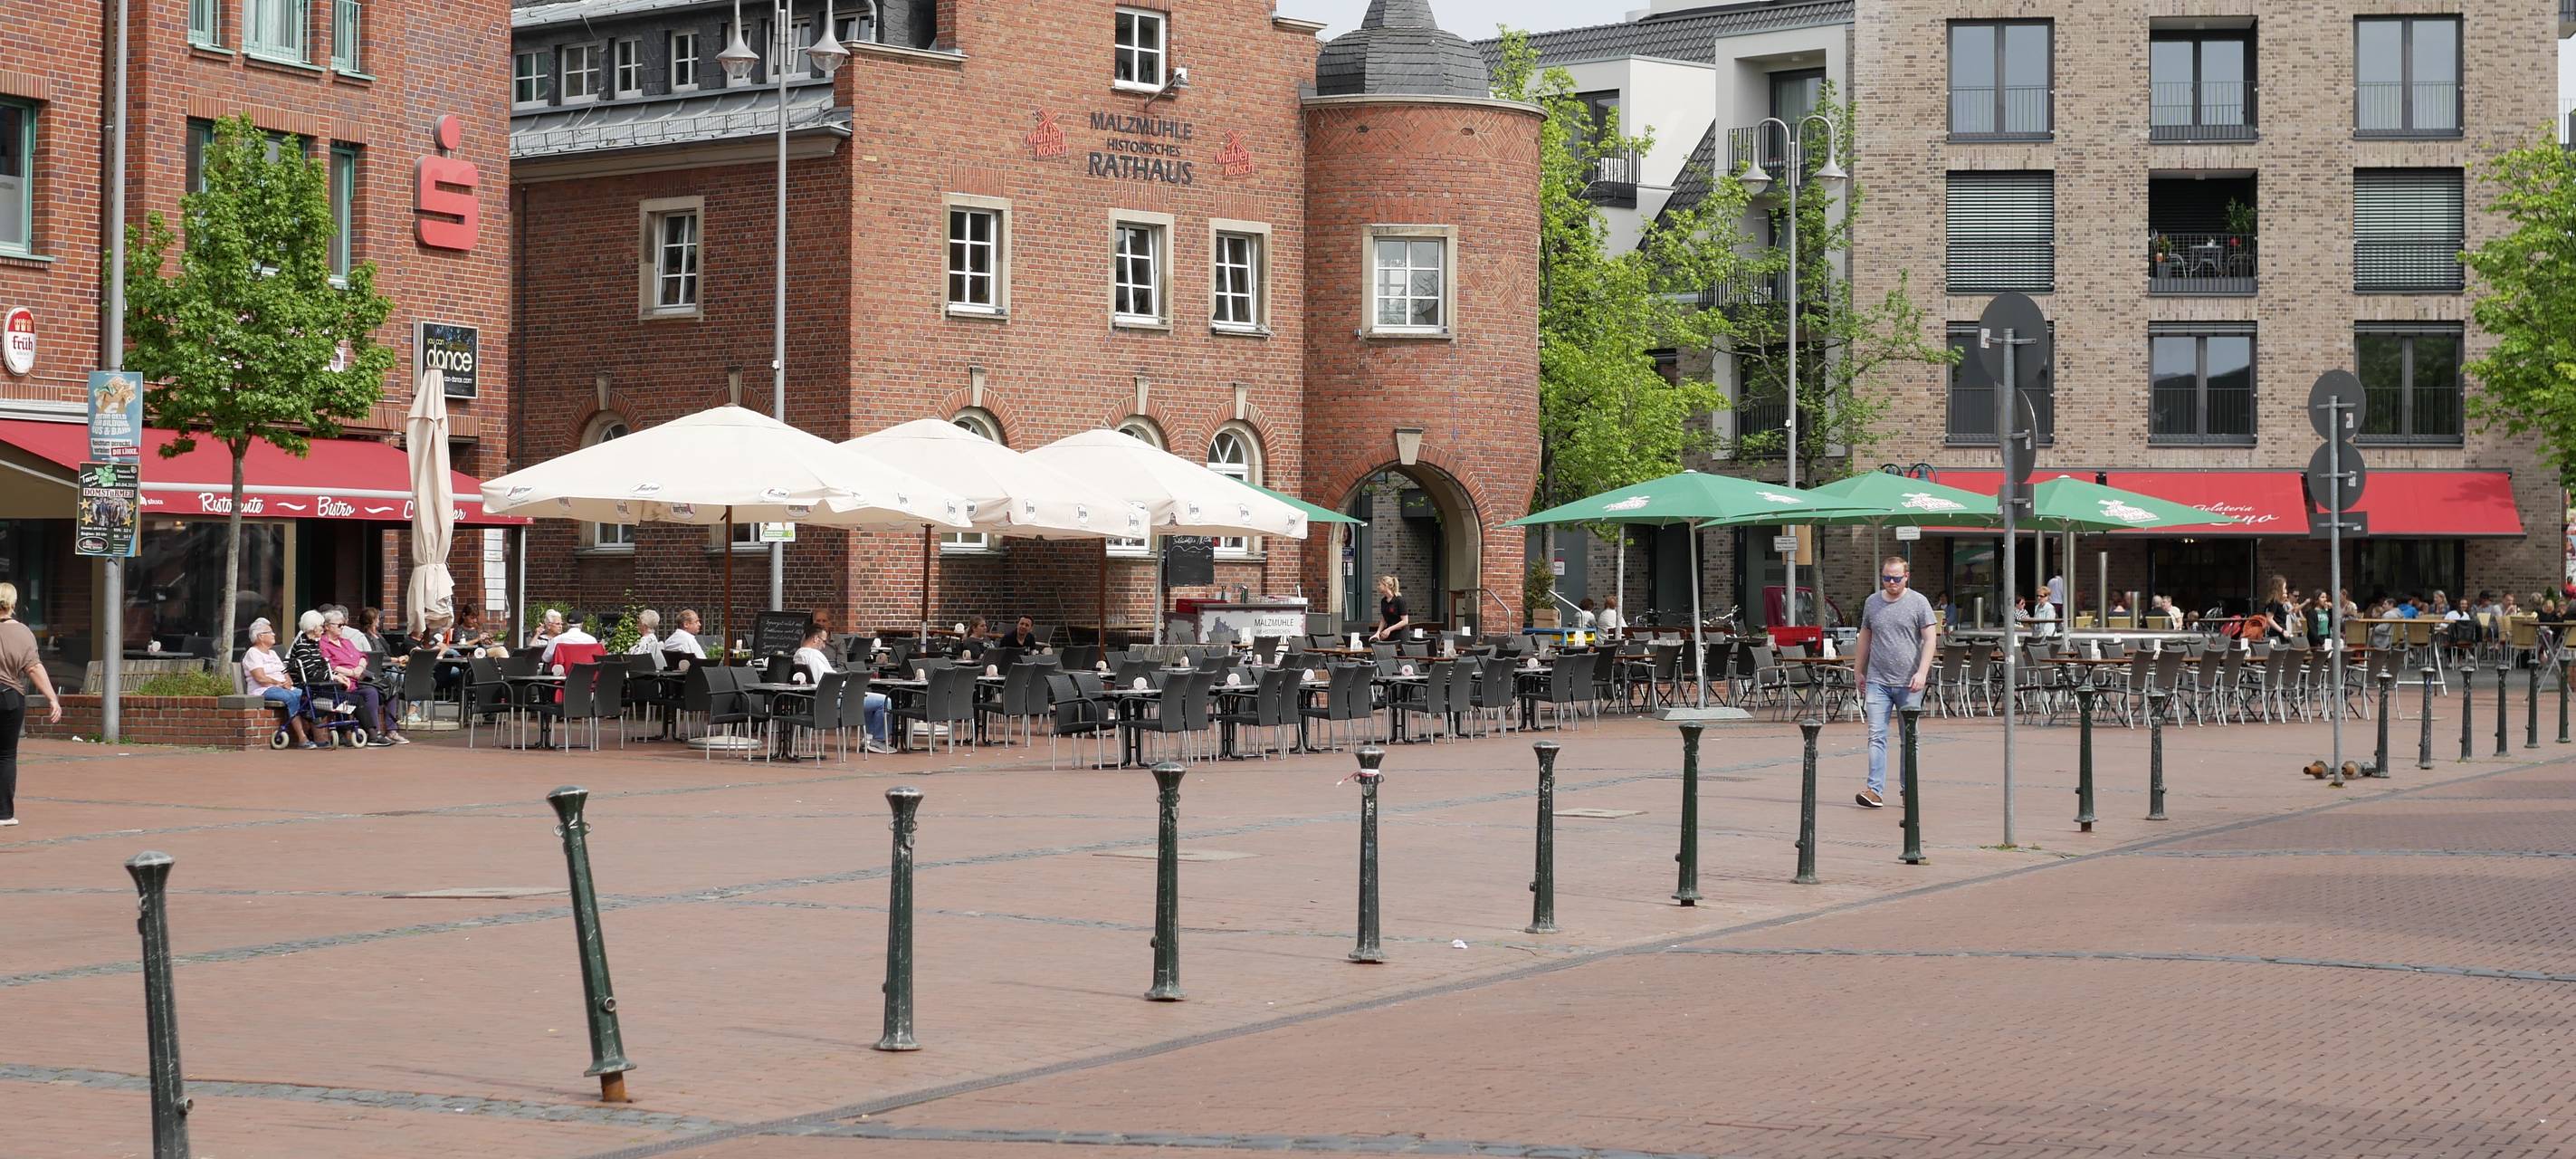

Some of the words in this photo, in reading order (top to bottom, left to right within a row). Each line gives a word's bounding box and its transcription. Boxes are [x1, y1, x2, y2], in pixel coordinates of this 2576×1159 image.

[1090, 111, 1193, 139] MALZMÜHLE
[1026, 128, 1065, 145] Mühlen
[1035, 142, 1068, 157] Kölsch
[1106, 139, 1181, 157] HISTORISCHES
[1214, 148, 1250, 164] Mühlen
[1088, 151, 1194, 185] RATHAUS
[1225, 162, 1254, 176] Kölsch
[12, 335, 33, 352] früh
[427, 344, 472, 371] dance
[197, 493, 264, 513] Ristonte
[317, 496, 355, 516] Bistro
